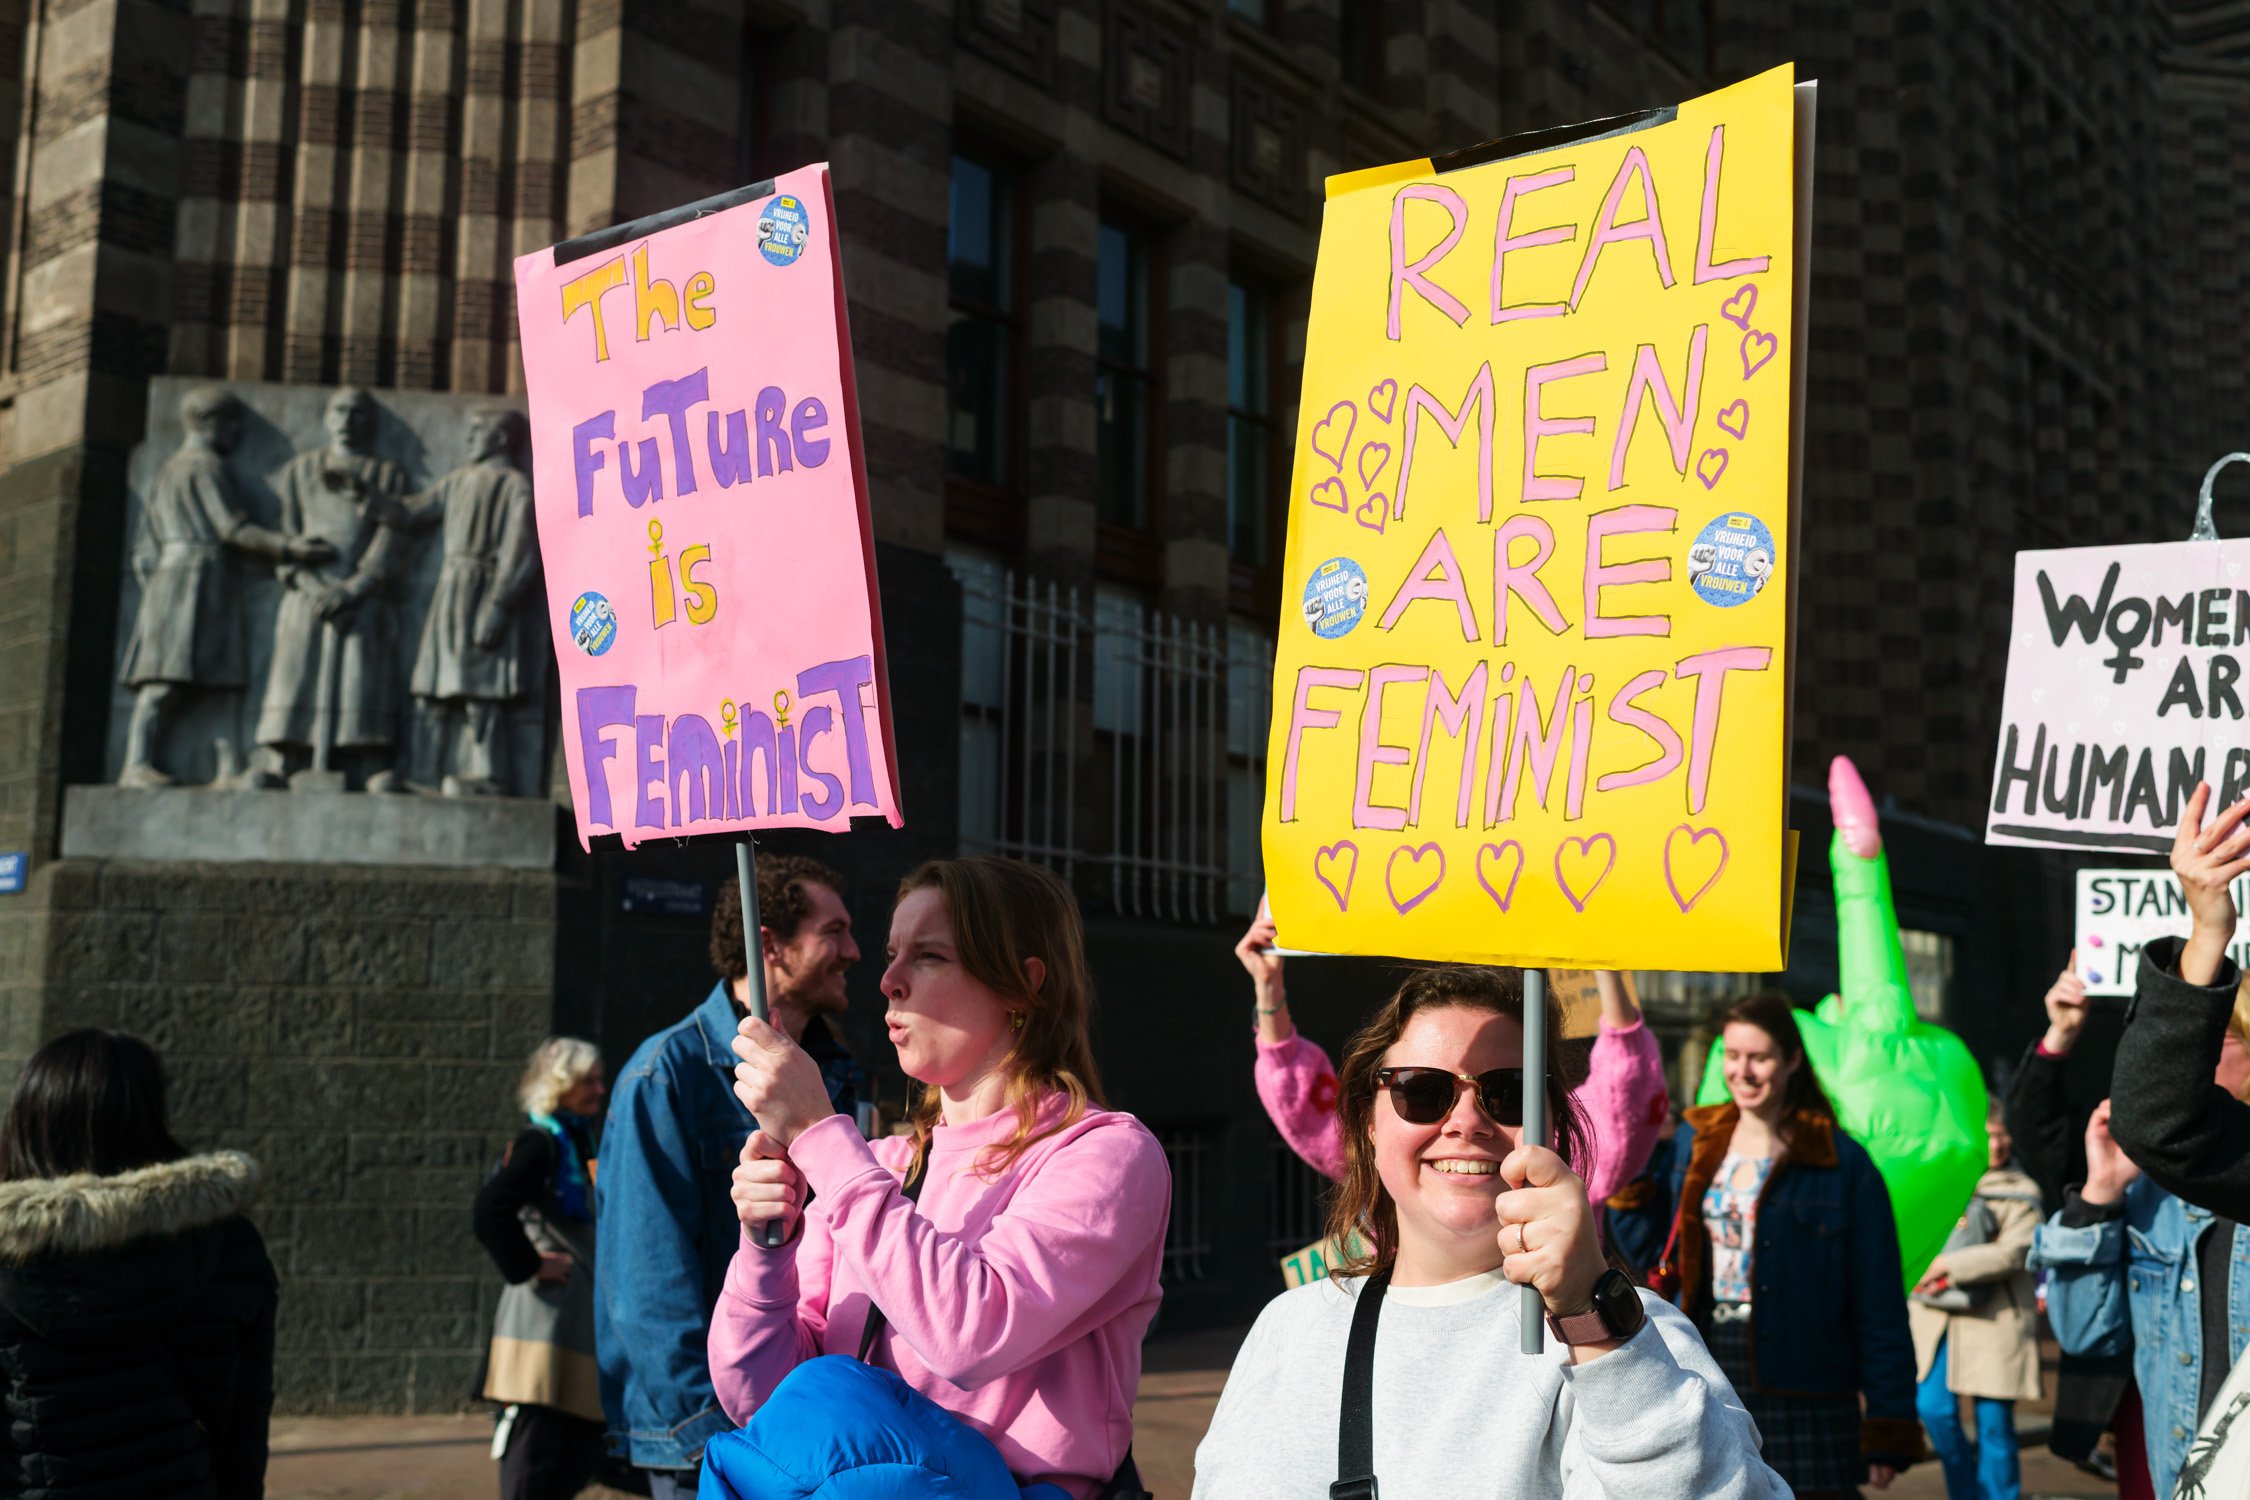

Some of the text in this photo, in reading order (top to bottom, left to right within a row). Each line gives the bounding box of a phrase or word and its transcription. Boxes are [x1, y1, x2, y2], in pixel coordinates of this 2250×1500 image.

[1387, 124, 1772, 341] REAL
[561, 240, 715, 362] The
[1393, 323, 1708, 524] MEN
[1715, 530, 1756, 548] VRIJHEID
[1718, 545, 1744, 562] VOOR
[648, 518, 717, 630] is
[1316, 570, 1348, 592] VRIJHEID
[1375, 505, 1678, 647] ARE
[1700, 574, 1748, 594] VROUWEN
[1715, 562, 1739, 576] ALLE
[1324, 586, 1344, 602] VOOR
[1327, 598, 1344, 614] ALLE
[1320, 606, 1356, 630] VROUWEN
[2157, 655, 2250, 720] AR
[1994, 723, 2205, 828] HUMAN
[2091, 878, 2187, 917] STAN
